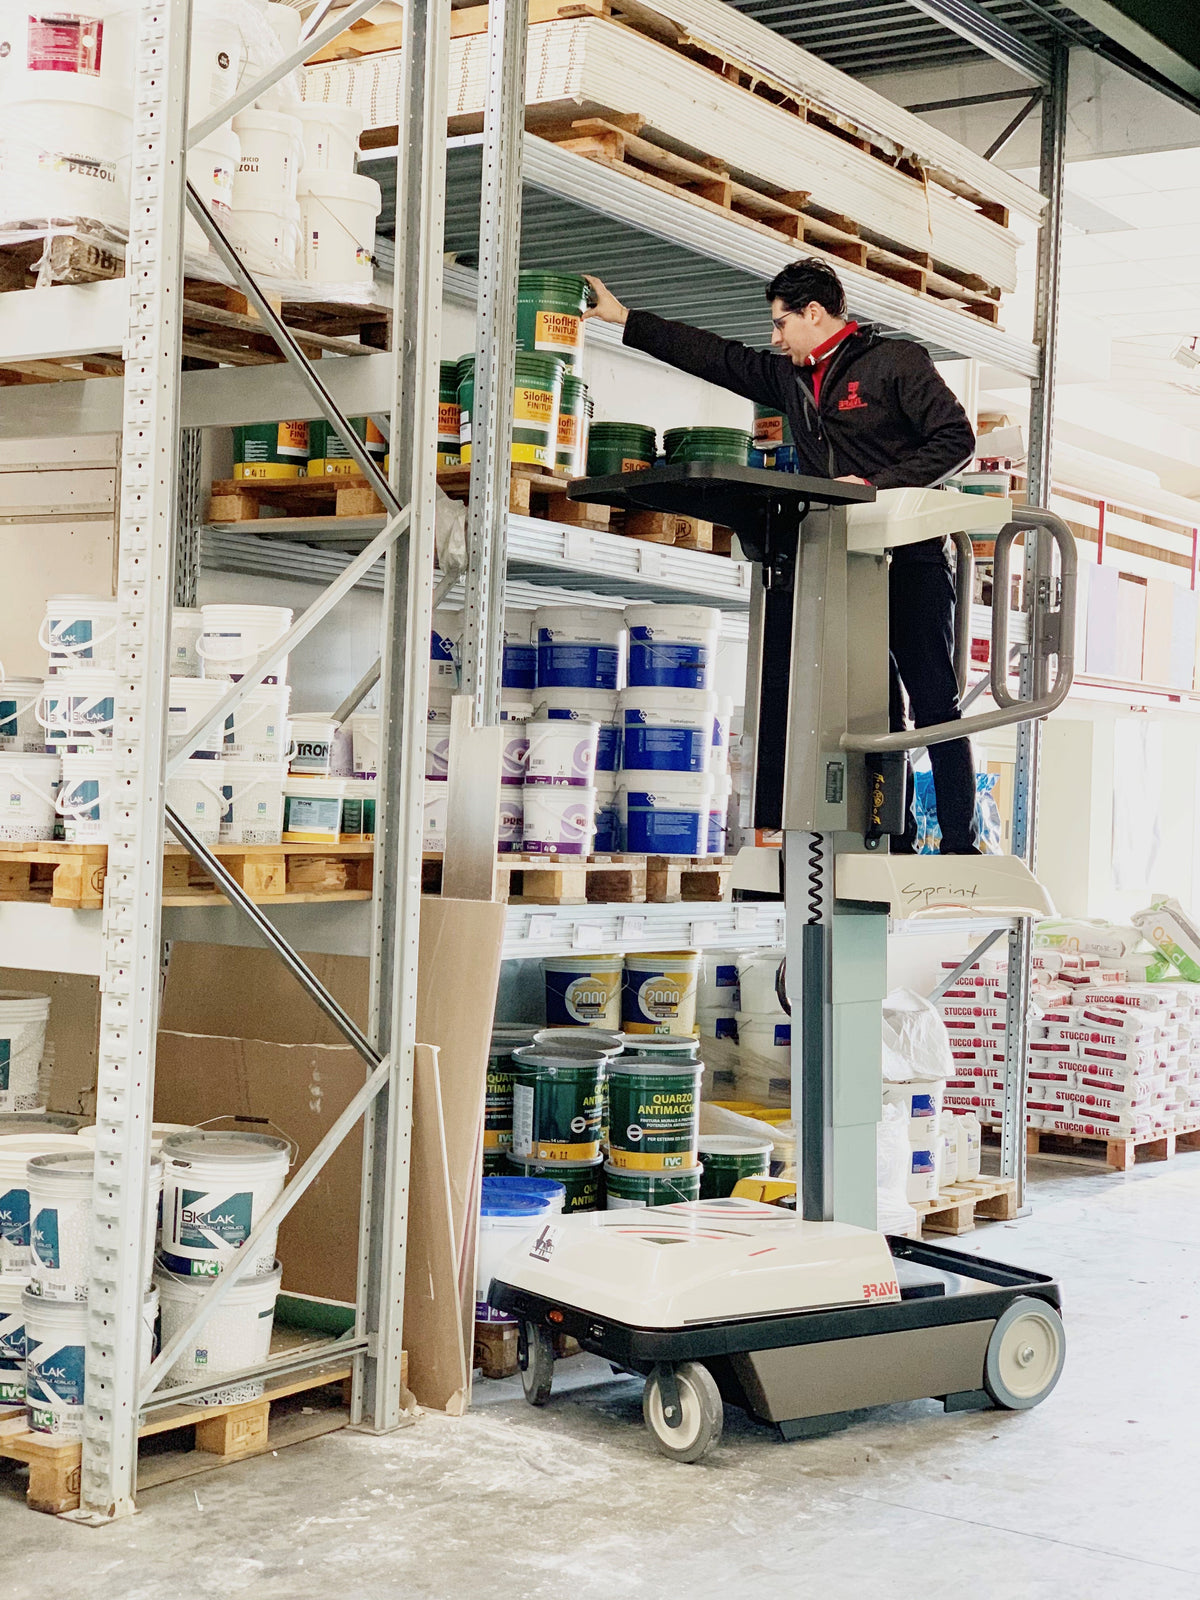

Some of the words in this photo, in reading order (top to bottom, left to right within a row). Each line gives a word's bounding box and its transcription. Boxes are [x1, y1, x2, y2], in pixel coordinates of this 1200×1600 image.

[69, 164, 117, 183] PEZZOLI
[86, 712, 105, 721] LAK
[901, 882, 979, 906] Sprint
[984, 978, 1000, 987] LITE
[573, 990, 607, 1005] 2000
[646, 989, 680, 1004] 2000
[1084, 994, 1114, 1004] STUCCO
[1125, 996, 1141, 1006] LITE
[944, 1006, 973, 1016] STUCCO
[982, 1007, 998, 1017] LITE
[654, 1026, 669, 1034] IVC
[948, 1038, 973, 1047] TUCCO
[982, 1039, 998, 1049] LITE
[1059, 1030, 1090, 1042] STUCCO
[1100, 1034, 1116, 1045] LITE
[983, 1068, 999, 1078] LITE
[1057, 1060, 1088, 1073] STUCCO
[1098, 1067, 1114, 1078] LITE
[652, 1092, 694, 1105] QUARZO
[943, 1095, 971, 1105] STUCCO
[980, 1097, 996, 1107] LITE
[1055, 1090, 1085, 1103] STUCCO
[1096, 1097, 1112, 1109] LITE
[1054, 1120, 1084, 1133] STUCCO
[1094, 1126, 1111, 1137] LITE
[664, 1157, 682, 1166] IVC
[0, 1210, 12, 1220] AK
[181, 1209, 205, 1225] BK
[207, 1213, 236, 1224] LAK
[192, 1261, 217, 1275] IVC
[41, 1365, 66, 1378] LAK
[2, 1385, 25, 1398] IVC
[34, 1410, 51, 1425] IVC
